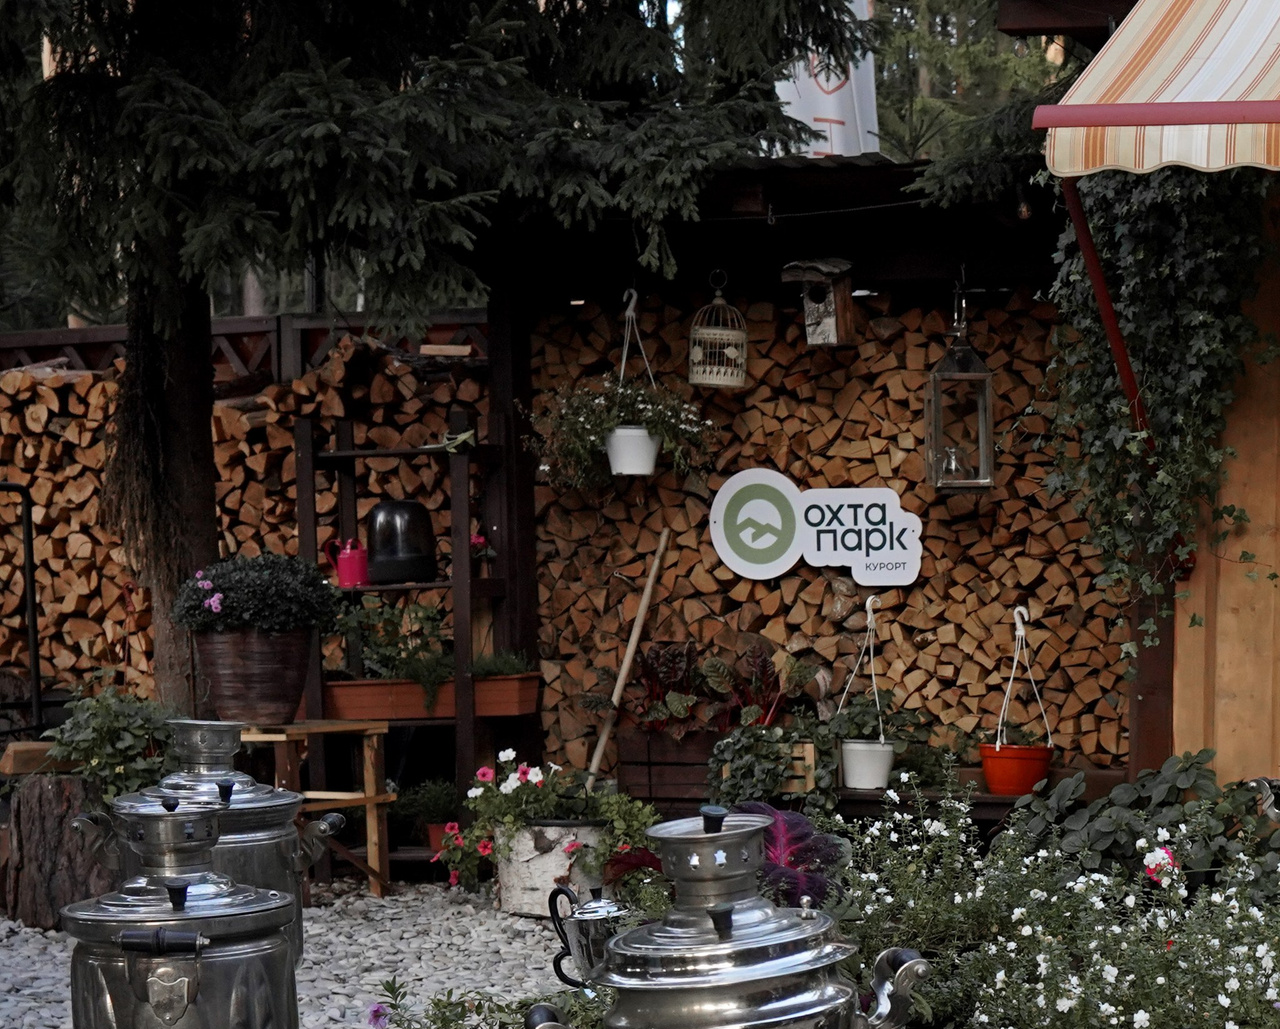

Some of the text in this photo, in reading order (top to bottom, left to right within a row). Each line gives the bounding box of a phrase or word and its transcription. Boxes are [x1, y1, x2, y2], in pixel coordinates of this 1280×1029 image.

[804, 503, 886, 527] охта
[817, 522, 907, 557] парк
[865, 562, 907, 571] КУРОРТ
